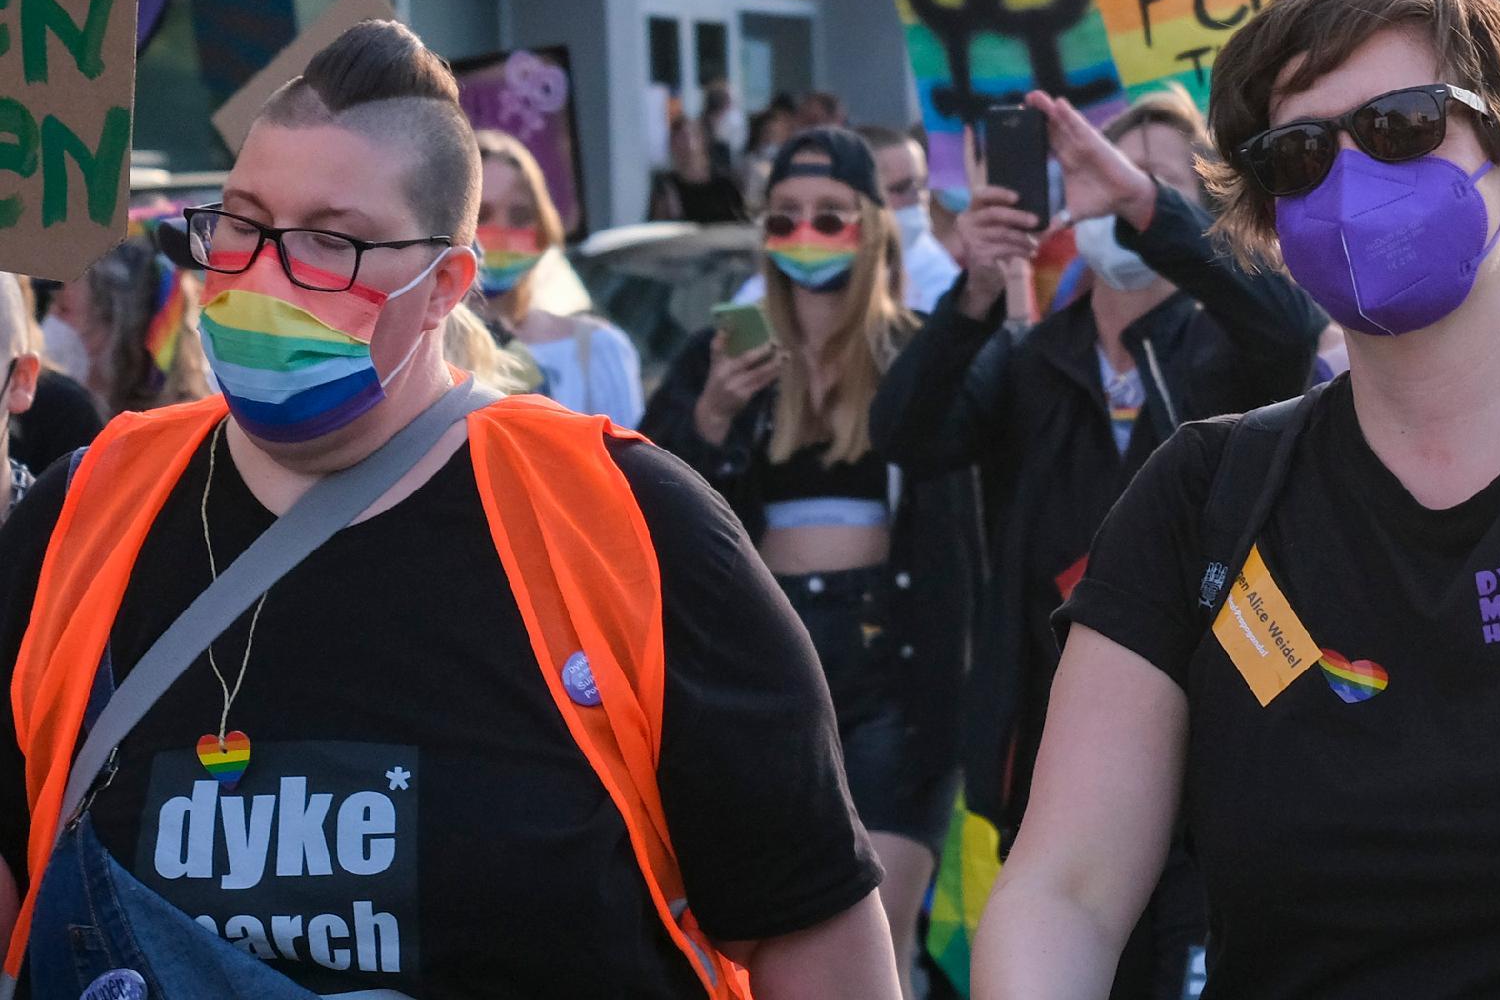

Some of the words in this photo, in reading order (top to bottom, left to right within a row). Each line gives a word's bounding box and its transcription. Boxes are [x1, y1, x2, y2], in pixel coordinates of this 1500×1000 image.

[1247, 590, 1270, 623] Alice
[1268, 619, 1303, 670] Weidel
[194, 900, 401, 973] arch
